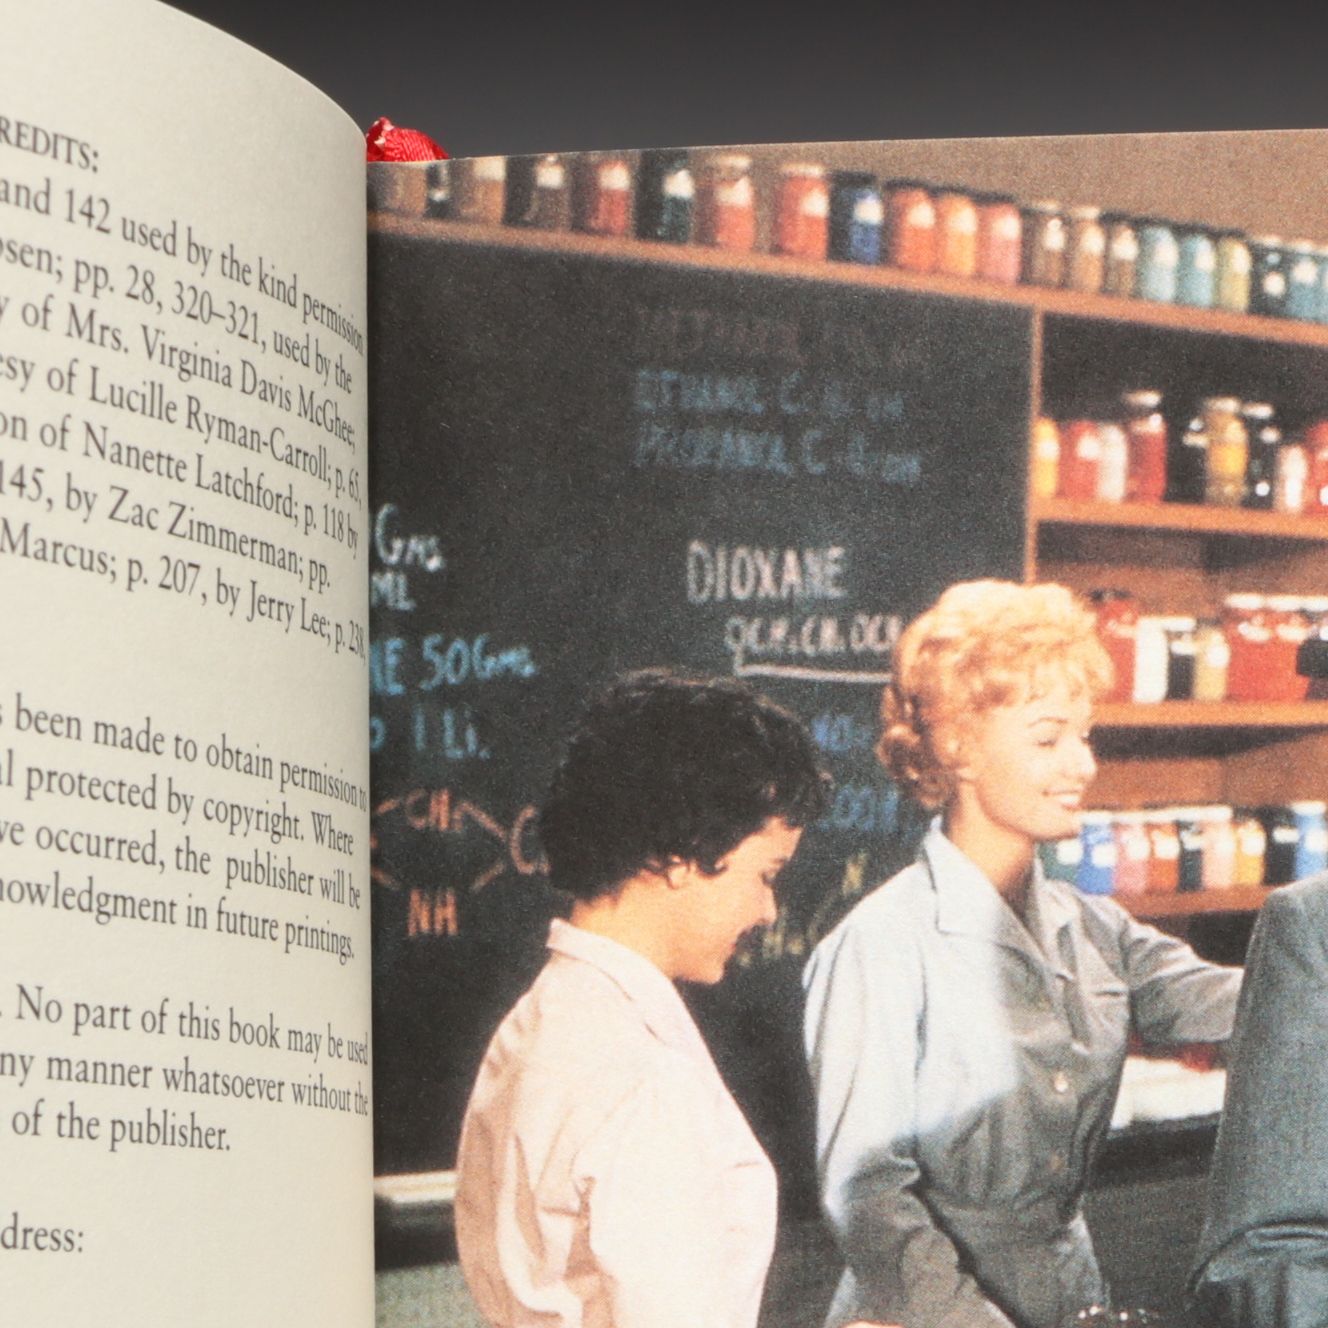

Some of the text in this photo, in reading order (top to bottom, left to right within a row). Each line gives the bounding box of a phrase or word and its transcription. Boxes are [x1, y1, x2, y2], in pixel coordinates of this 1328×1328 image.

[0, 177, 364, 357] and 142 used by the kind permission
[21, 294, 356, 456] of Mrs. Virginia Davis McGhee;
[74, 258, 115, 299] pp.
[125, 264, 164, 314] 28,
[273, 329, 311, 369] used
[315, 337, 331, 387] by
[335, 353, 352, 394] the
[46, 358, 79, 395] of
[89, 365, 178, 424] Lucille
[186, 395, 332, 490] Ryman-Carroll;
[335, 467, 346, 499] p.
[40, 414, 71, 452] of
[83, 421, 188, 482] Nanette
[195, 453, 300, 528] Latchford;
[304, 503, 317, 537] p.
[323, 503, 344, 543] 118
[347, 512, 358, 560] by
[65, 472, 97, 523] by
[107, 485, 159, 532] Zac
[167, 500, 304, 582] Zimmerman;
[308, 557, 331, 597] pp.
[0, 517, 118, 583] Marcus;
[126, 557, 149, 592] p.
[157, 555, 208, 606] 207,
[216, 567, 241, 617] by
[246, 579, 295, 634] Jerry
[300, 597, 332, 646] Lee;
[335, 622, 346, 653] p.
[686, 540, 850, 605] DIOXANE
[15, 692, 82, 742] been
[93, 717, 165, 756] made
[174, 735, 198, 763] to
[206, 733, 274, 780] obtain
[279, 759, 358, 807] permission
[25, 764, 157, 811] protected
[167, 778, 194, 826] by
[203, 797, 304, 844] copyright.
[311, 811, 354, 856] Where
[0, 870, 355, 965] owledgment in future printings.
[36, 825, 165, 876] occurred,
[174, 836, 212, 875] the
[225, 848, 315, 897] publisher
[320, 868, 346, 907] will
[349, 874, 361, 910] be
[15, 983, 369, 1067] No part of this book may be used
[0, 1052, 369, 1117] ny manner whatsoever without the
[12, 1098, 232, 1152] of the publisher.
[0, 1211, 85, 1253] dress:
